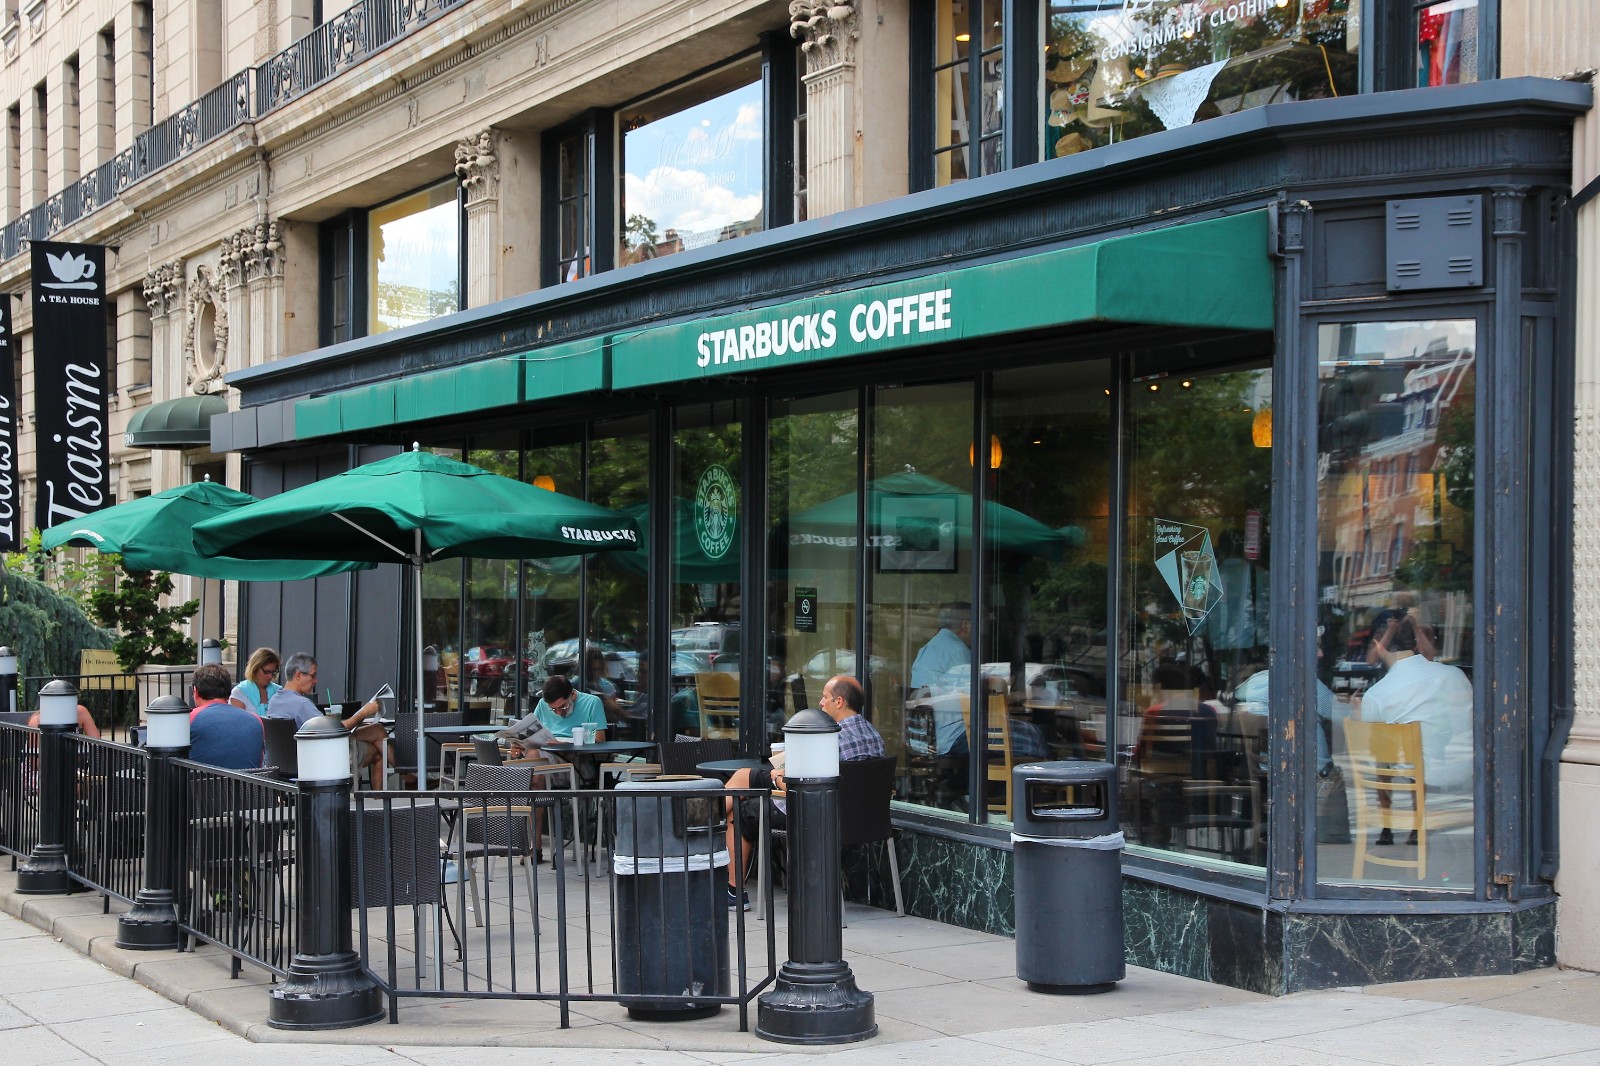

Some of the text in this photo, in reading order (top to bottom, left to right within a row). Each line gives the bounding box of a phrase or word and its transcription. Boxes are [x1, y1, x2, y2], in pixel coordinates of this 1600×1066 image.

[1101, 0, 1277, 62] CONSIGNMENT CLOTHIN
[40, 294, 100, 306] A TEA HOUSE
[697, 288, 952, 368] STARBUCKS COFFEE
[46, 361, 103, 529] Teaism
[698, 468, 735, 508] STARBUCKS
[561, 526, 637, 542] STARBUCKS
[701, 531, 730, 554] COFFEE
